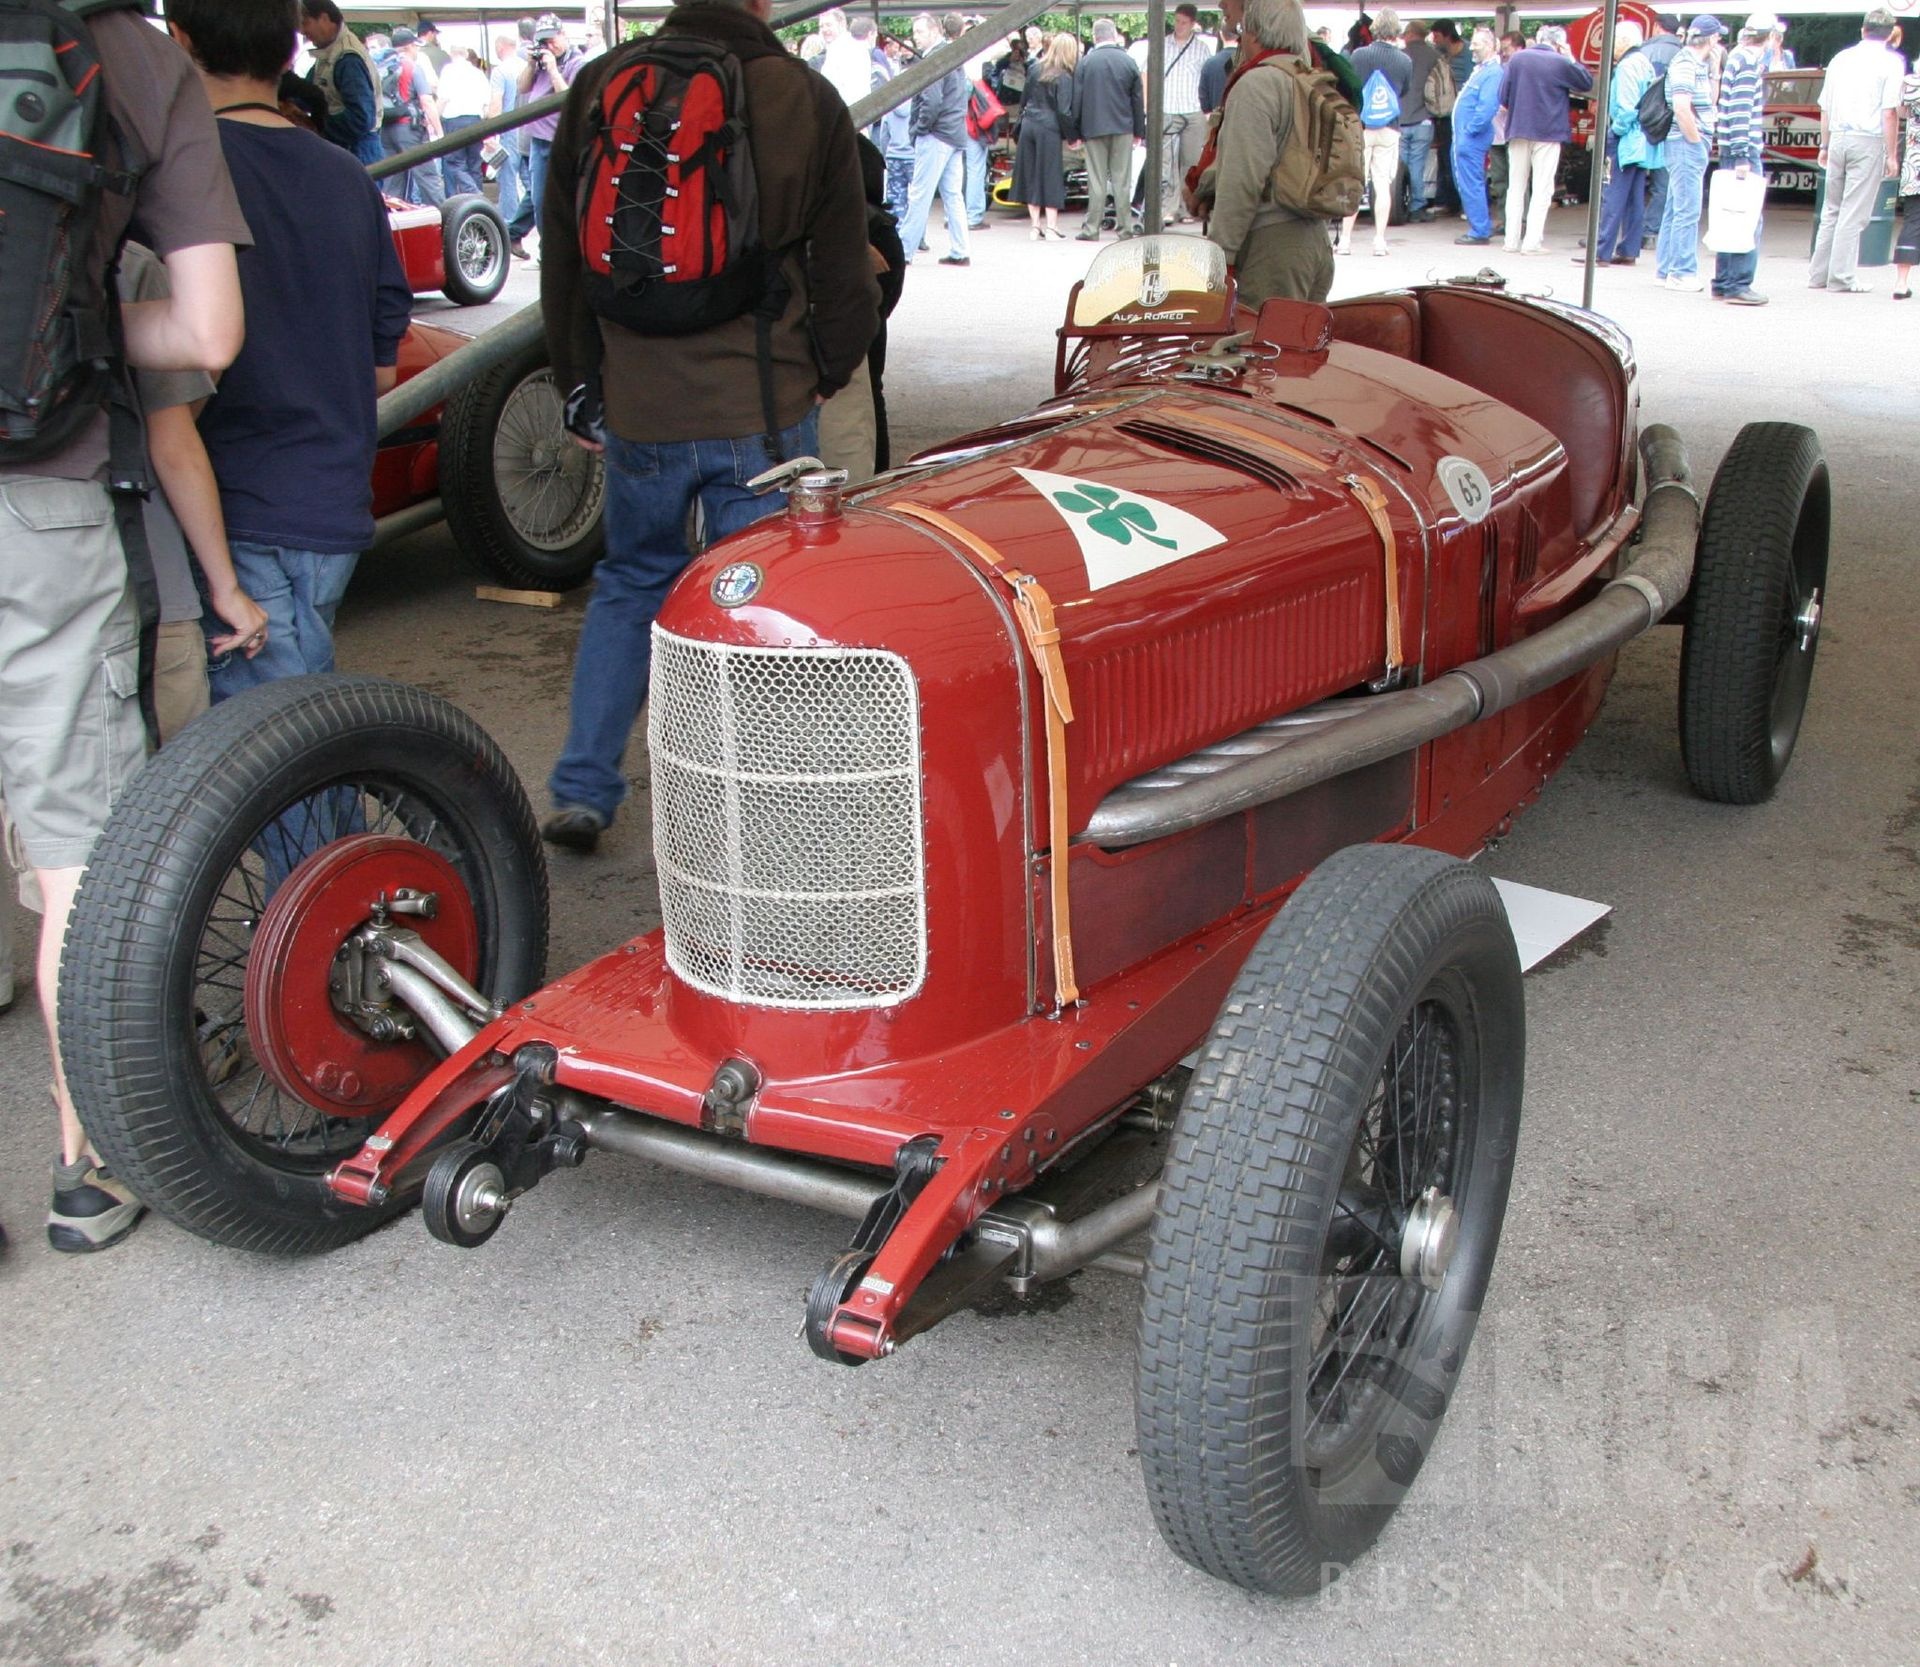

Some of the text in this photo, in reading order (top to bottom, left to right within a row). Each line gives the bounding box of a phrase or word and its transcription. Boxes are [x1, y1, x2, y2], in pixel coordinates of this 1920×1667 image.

[1112, 312, 1184, 321] ALFA ROMEO
[1458, 472, 1482, 507] 65
